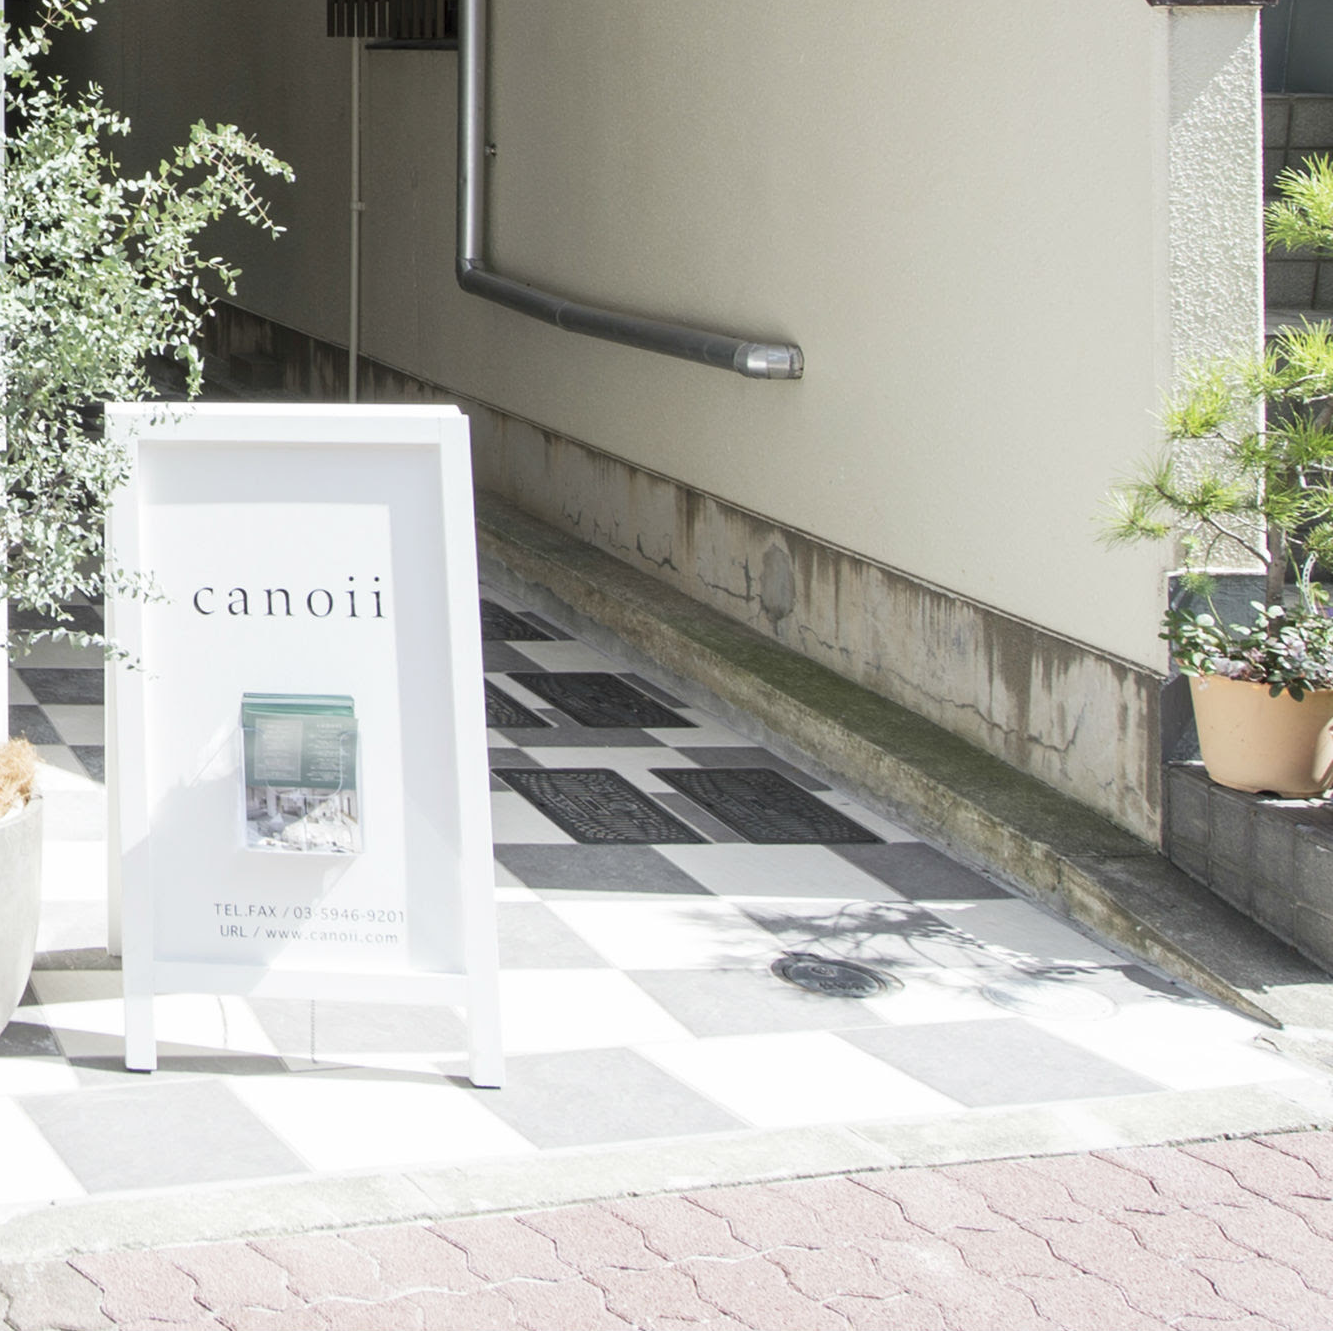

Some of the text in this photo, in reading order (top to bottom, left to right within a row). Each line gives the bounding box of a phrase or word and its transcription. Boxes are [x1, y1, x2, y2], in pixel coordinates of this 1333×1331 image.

[193, 575, 388, 619] canoii
[293, 905, 405, 923] 03-5946-9201
[219, 924, 248, 938] URL
[265, 927, 399, 945] www.canoii.com
